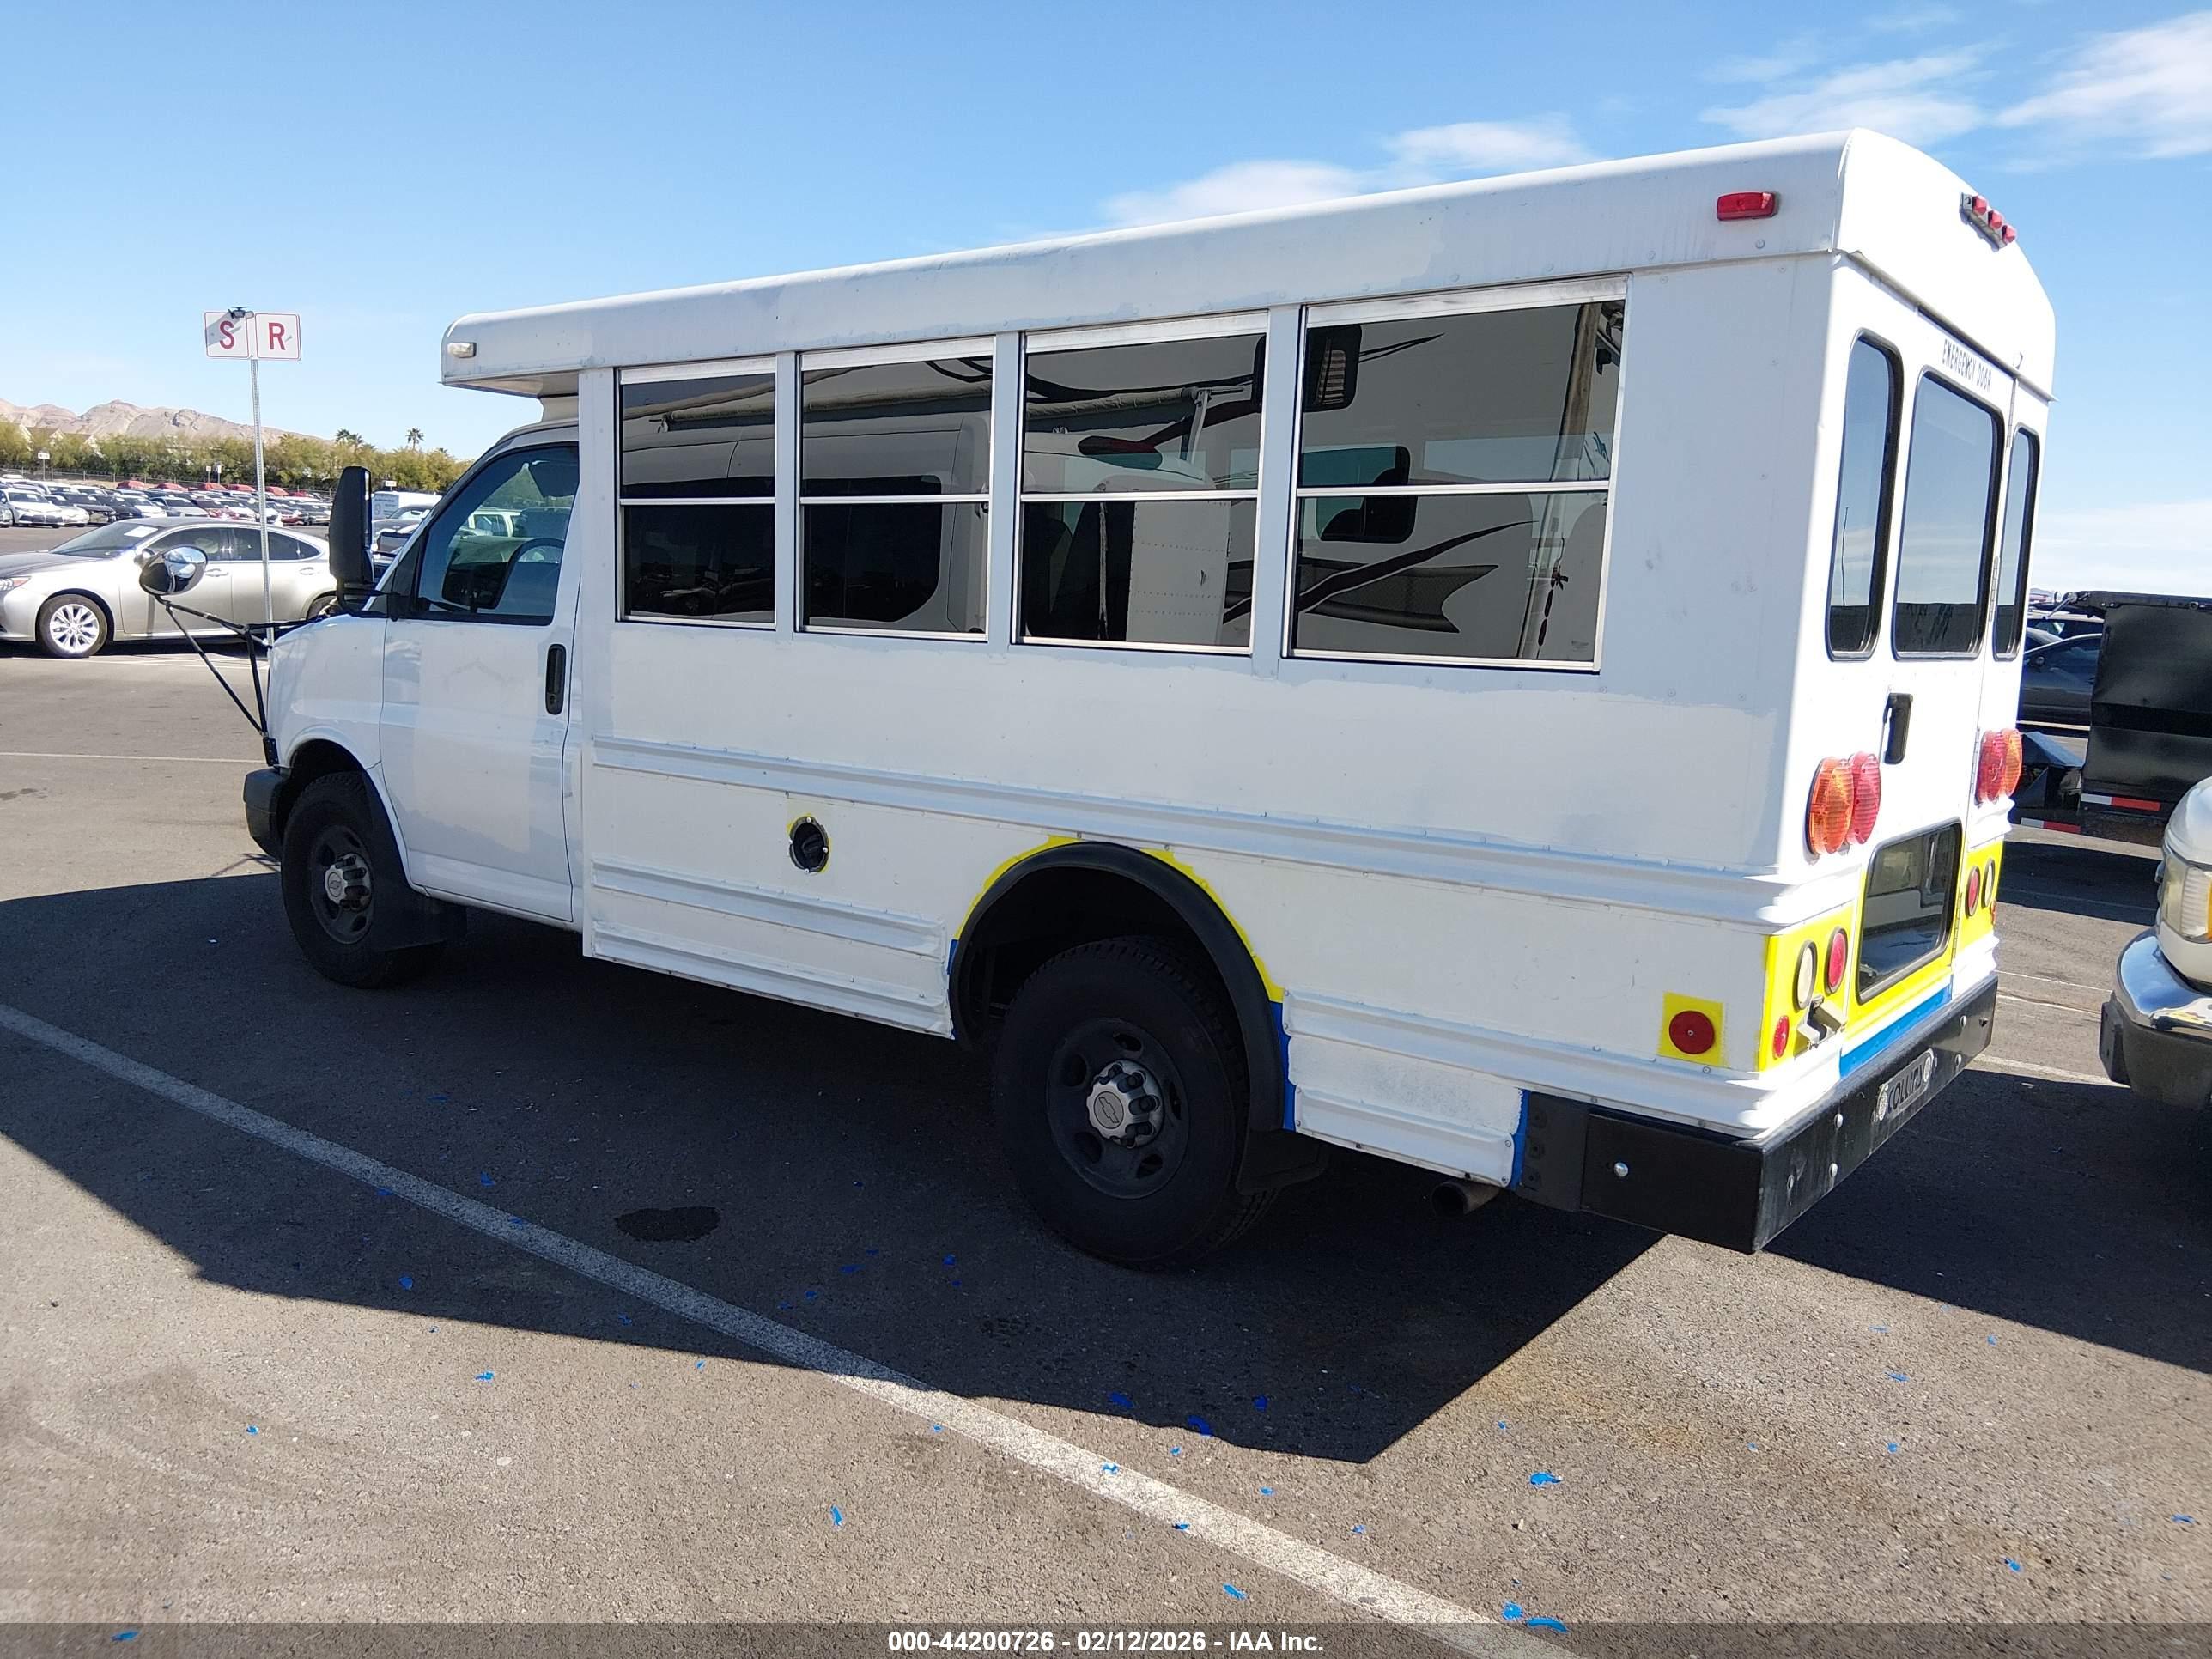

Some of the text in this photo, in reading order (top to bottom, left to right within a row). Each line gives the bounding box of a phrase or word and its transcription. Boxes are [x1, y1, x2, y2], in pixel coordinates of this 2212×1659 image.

[219, 320, 235, 349] S
[268, 322, 286, 350] R
[1942, 338, 1993, 392] EMERGENCY DOOR
[1887, 1064, 1923, 1115] COLLINS
